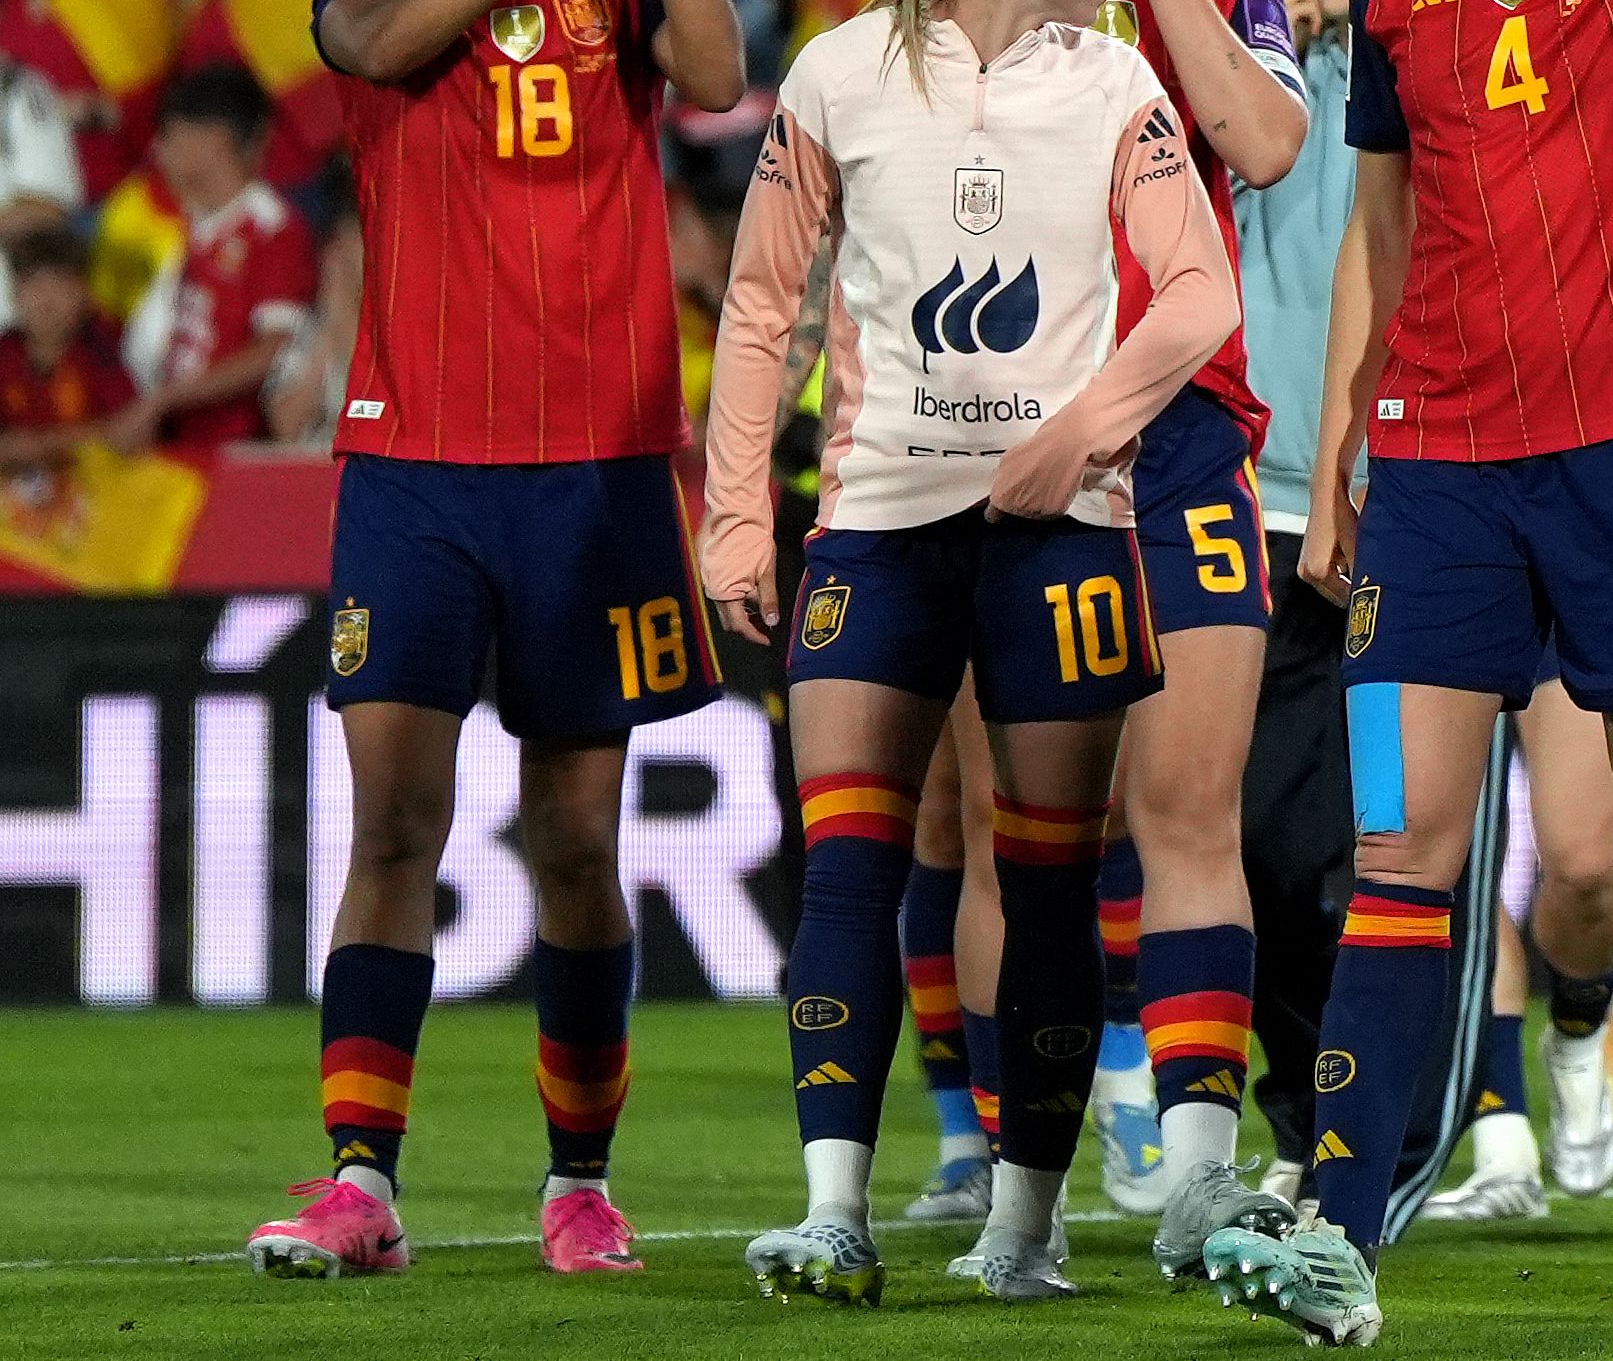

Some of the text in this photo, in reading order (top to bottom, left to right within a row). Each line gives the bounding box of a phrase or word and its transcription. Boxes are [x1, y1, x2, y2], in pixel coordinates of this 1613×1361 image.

[489, 63, 573, 158] 18
[1485, 15, 1549, 114] 4
[913, 386, 1043, 423] Iberdrola
[1184, 503, 1248, 594] 5
[608, 595, 688, 701] 18
[1045, 574, 1128, 684] 10
